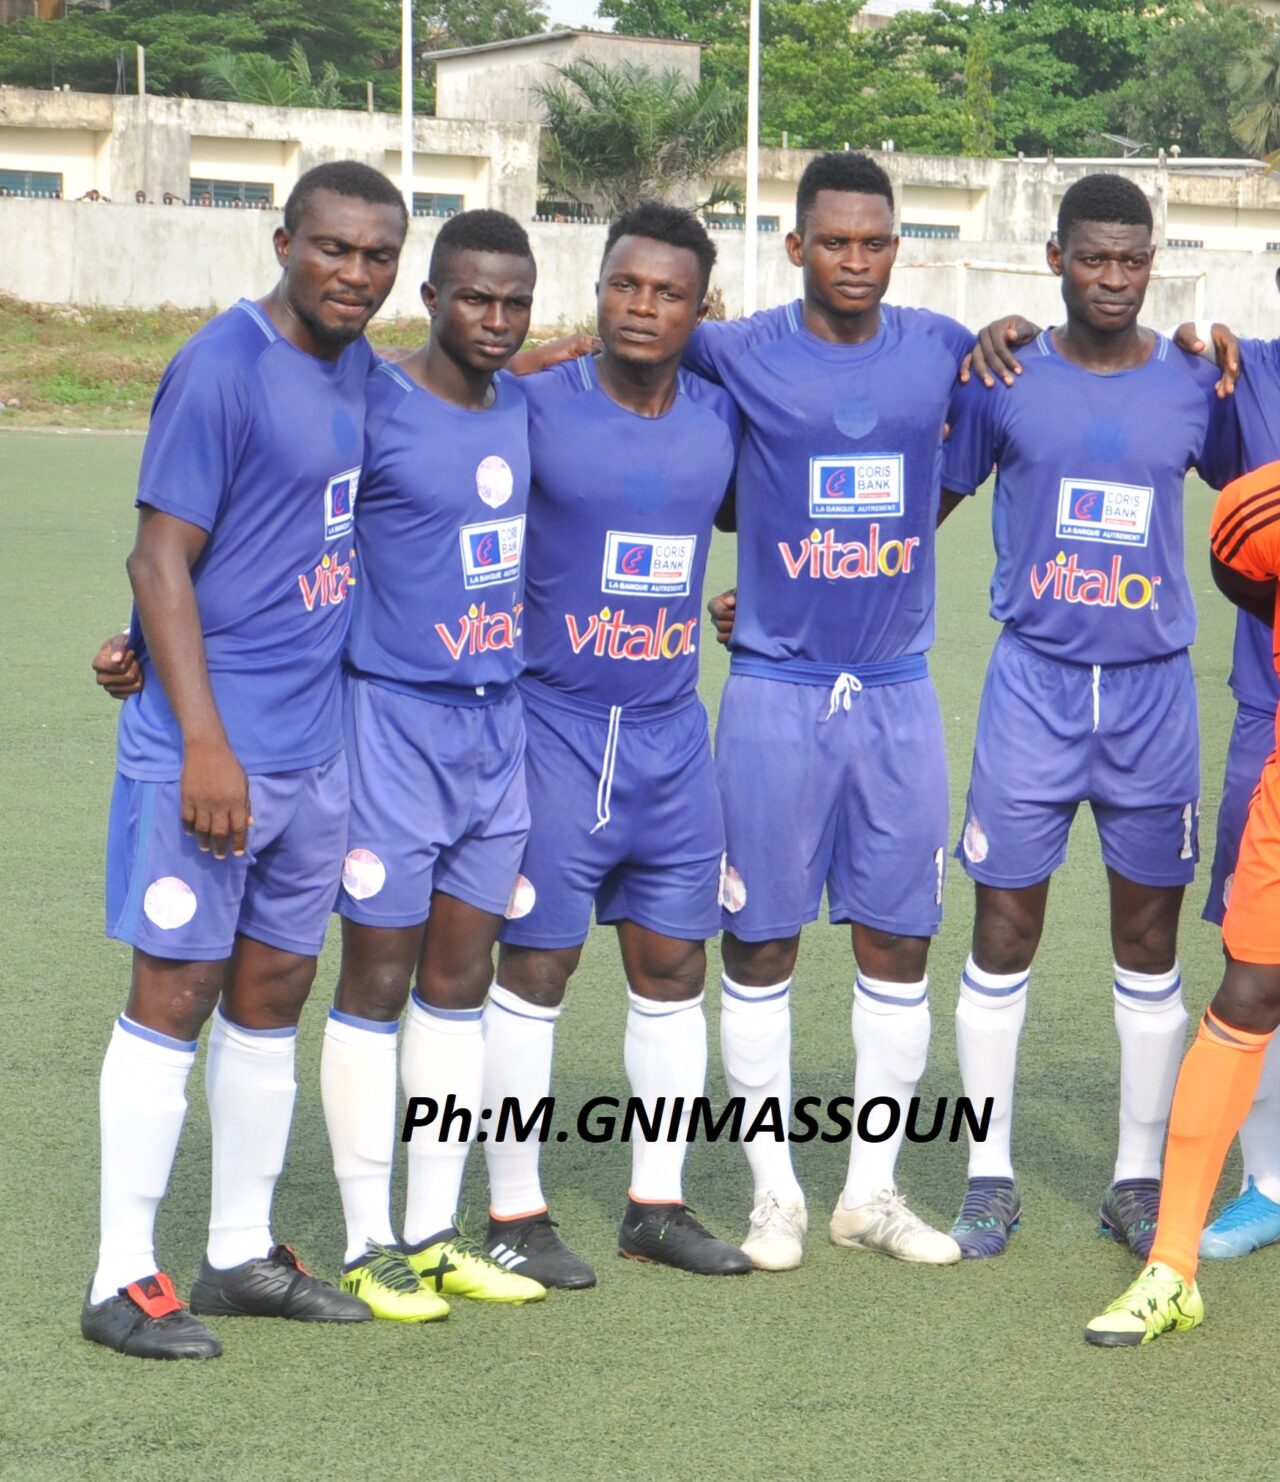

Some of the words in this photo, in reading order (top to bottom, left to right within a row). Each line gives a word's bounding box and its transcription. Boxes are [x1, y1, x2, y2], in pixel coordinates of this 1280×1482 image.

[858, 466, 890, 478] CORIS
[858, 480, 890, 490] BANK
[1107, 492, 1140, 507] CORIS
[1105, 506, 1137, 518] BANK
[656, 545, 686, 558] CORIS
[653, 560, 684, 570] BANK
